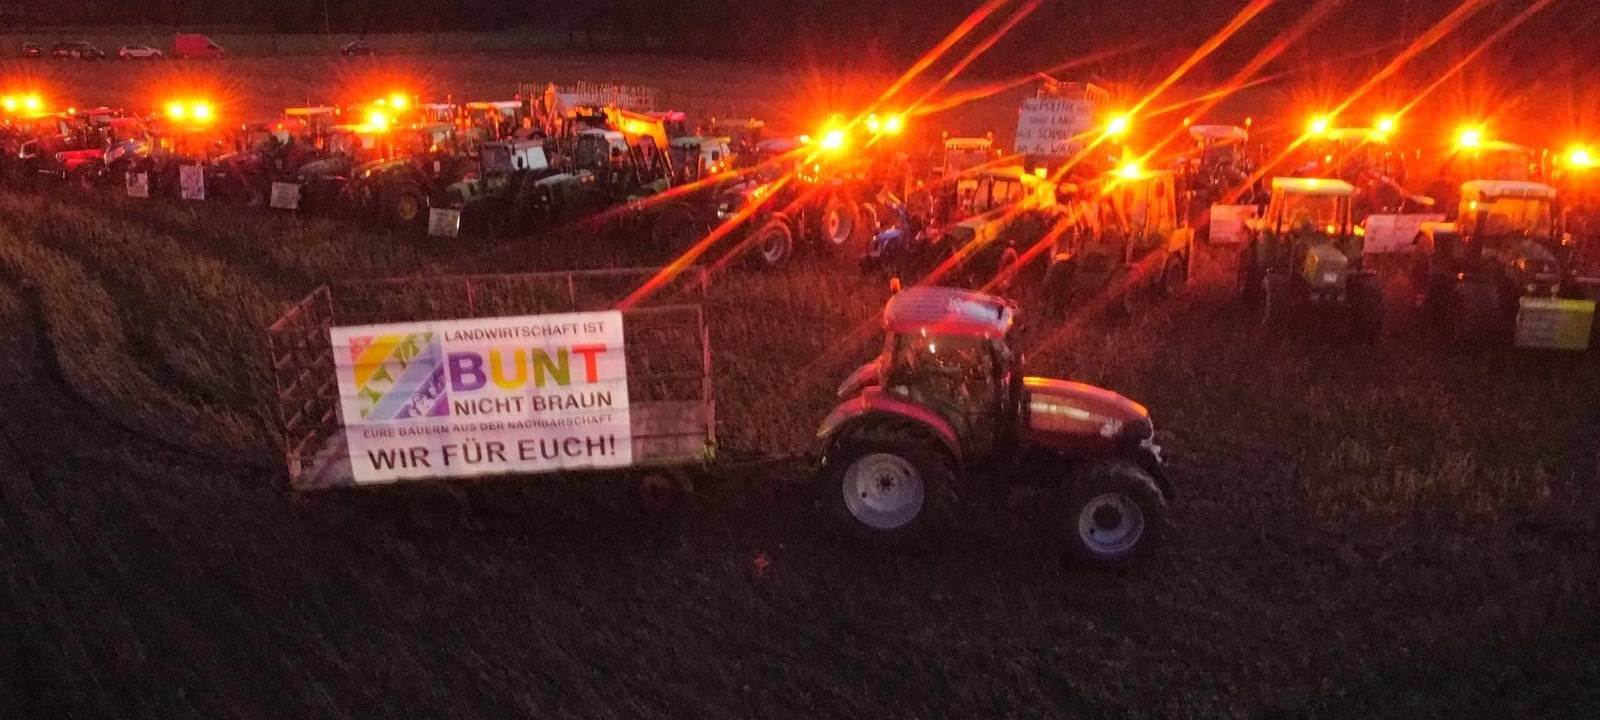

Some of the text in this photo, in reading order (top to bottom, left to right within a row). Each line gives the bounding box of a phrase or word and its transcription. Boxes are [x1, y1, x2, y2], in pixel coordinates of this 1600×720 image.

[444, 321, 606, 342] LANDWIRTSCHAFT IST
[447, 343, 607, 392] BUNT
[454, 391, 612, 416] NICHT BRAUN
[363, 414, 613, 439] EURE BAUERN AUS DER NACHBARSCHAFT
[367, 434, 616, 471] WIR FÜR EUCH!
